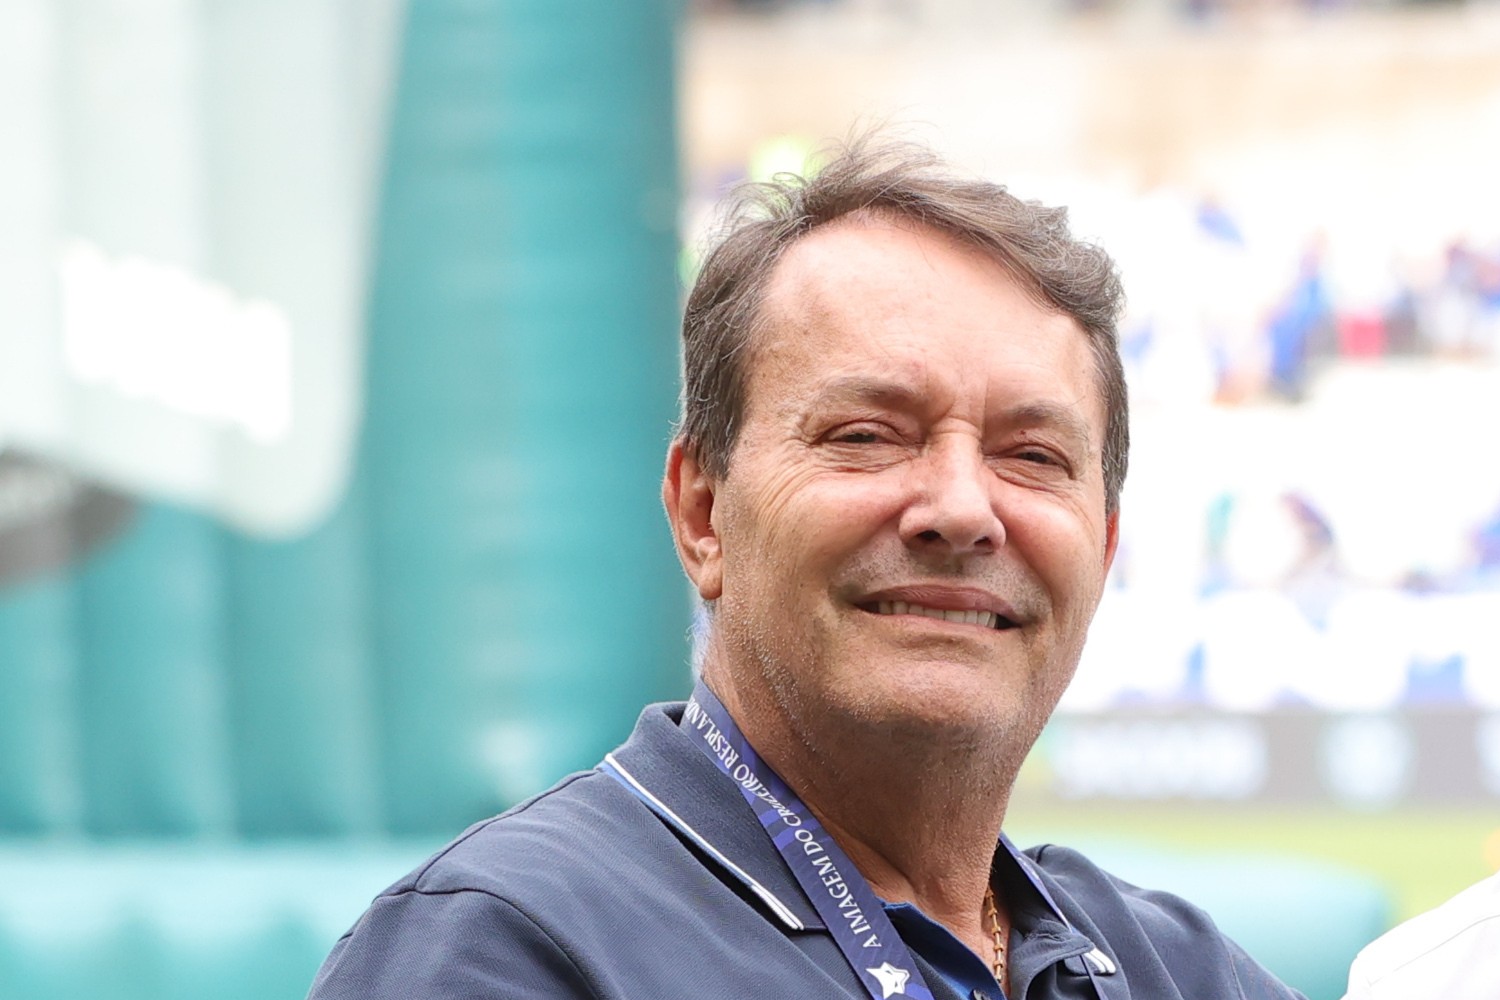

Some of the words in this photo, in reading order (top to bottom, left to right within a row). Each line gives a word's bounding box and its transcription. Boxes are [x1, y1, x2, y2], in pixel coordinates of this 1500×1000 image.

[733, 763, 802, 827] CRUZEIRO
[794, 829, 824, 856] DO
[812, 855, 871, 935] IMAGEM
[863, 934, 882, 948] A
